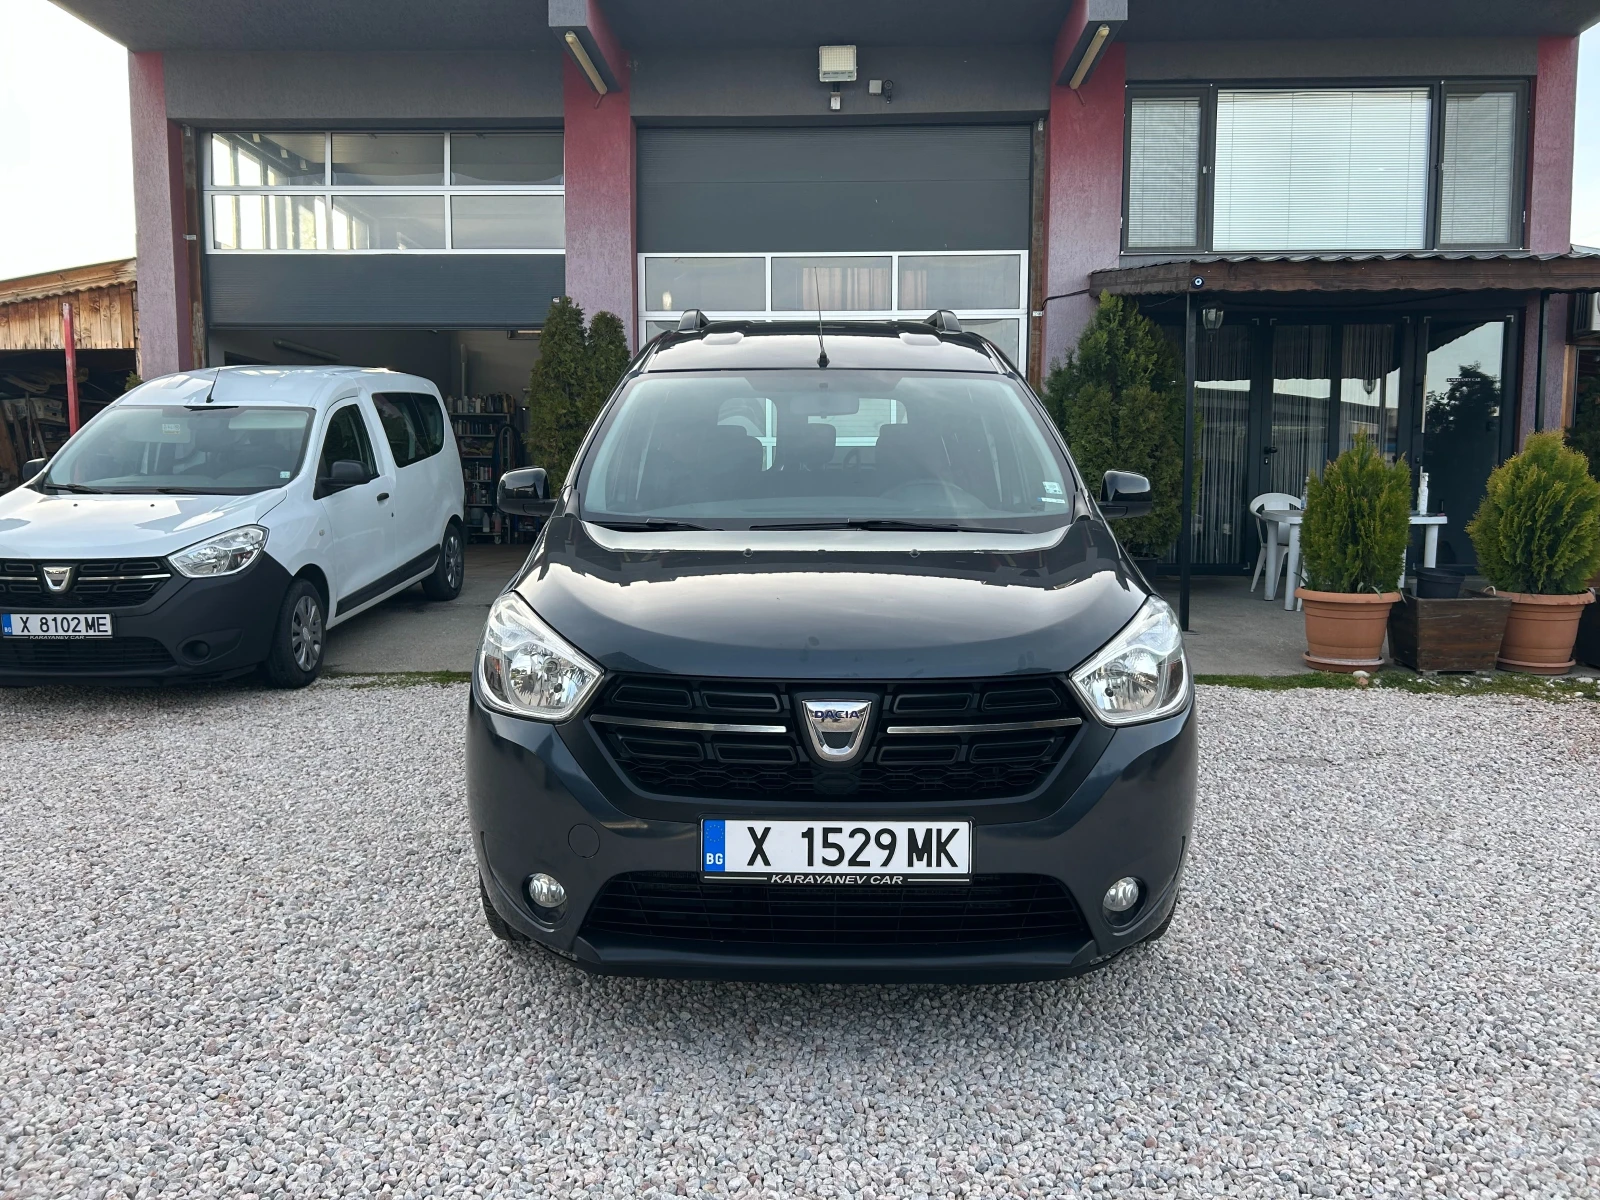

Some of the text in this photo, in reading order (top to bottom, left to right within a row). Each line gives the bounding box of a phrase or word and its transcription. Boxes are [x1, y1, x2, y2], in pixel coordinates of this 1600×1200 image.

[19, 616, 109, 633] X 8102 ME
[814, 710, 860, 719] DACIA
[746, 826, 960, 868] X 1529 MK
[706, 853, 724, 865] BG
[770, 874, 904, 886] KARAYANEV CAR
